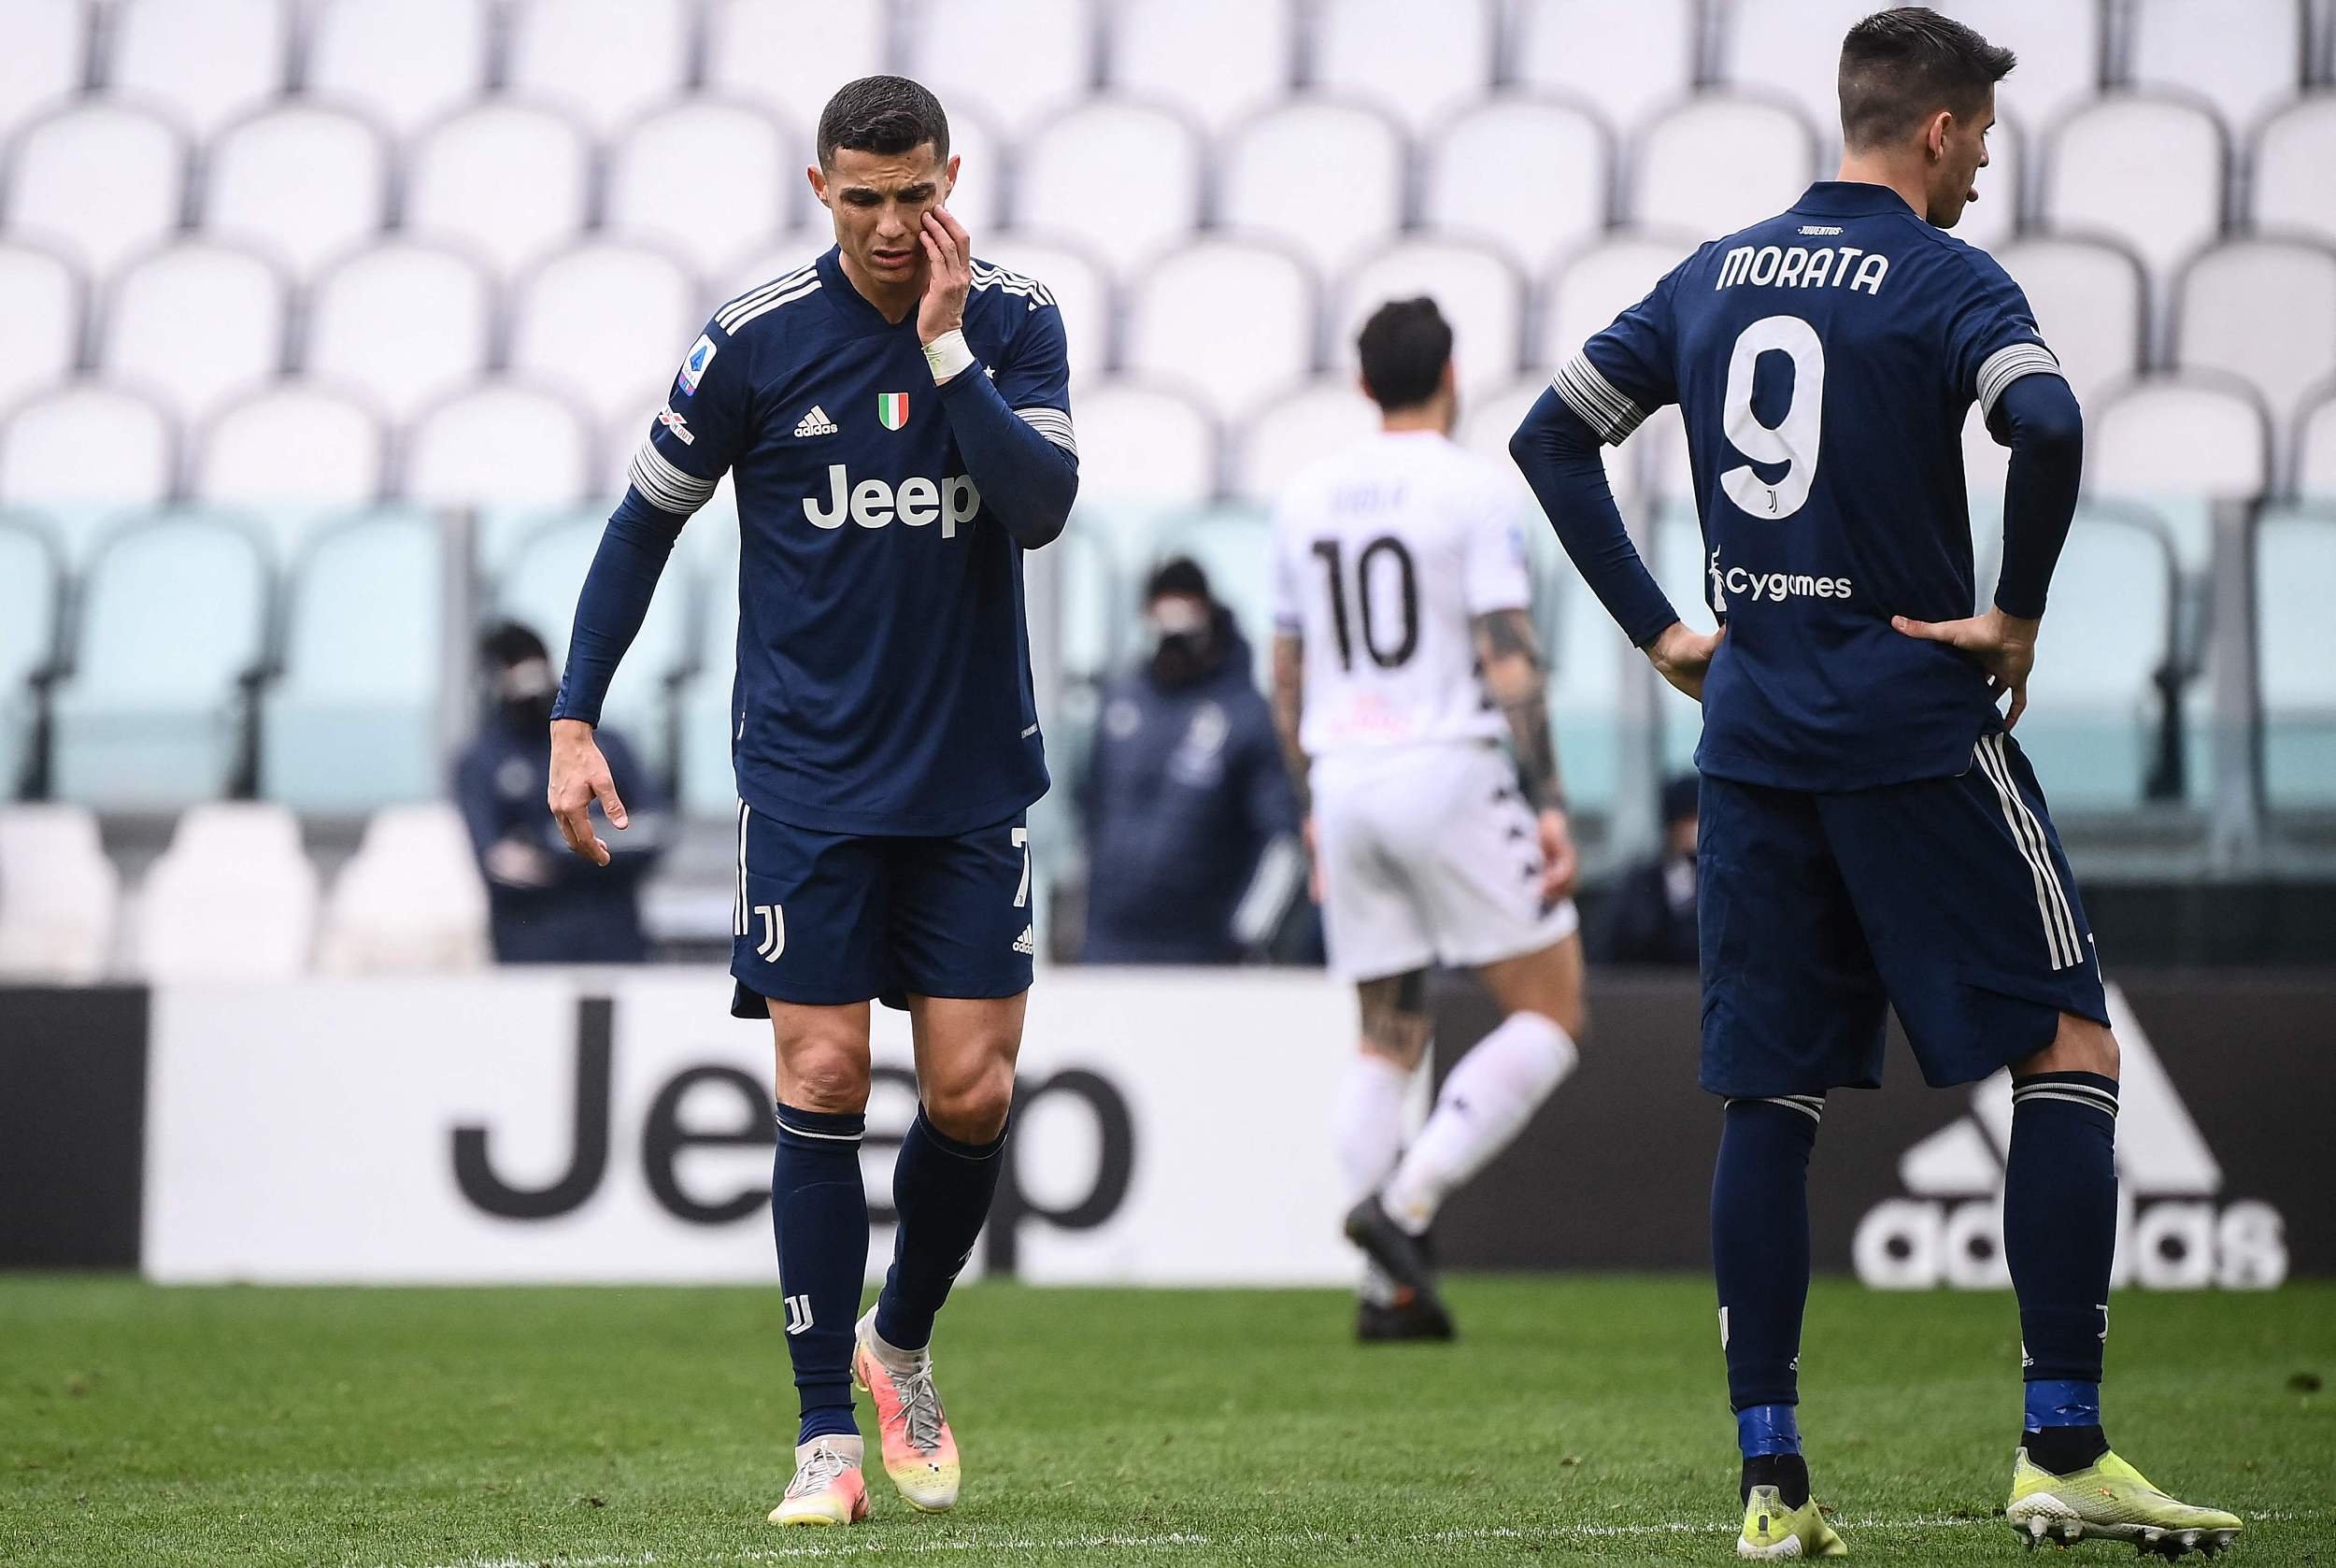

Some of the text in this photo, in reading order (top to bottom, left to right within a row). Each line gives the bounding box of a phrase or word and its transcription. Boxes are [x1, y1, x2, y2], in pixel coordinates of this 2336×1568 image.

[1799, 225, 1843, 235] JUVENTUS
[1716, 245, 1889, 295] MORATA
[793, 423, 838, 437] adidas
[1719, 314, 1826, 520] 9
[801, 463, 981, 539] Jeep
[1311, 535, 1419, 674] 10
[1011, 827, 1031, 907] 7
[1851, 1194, 2289, 1290] adas
